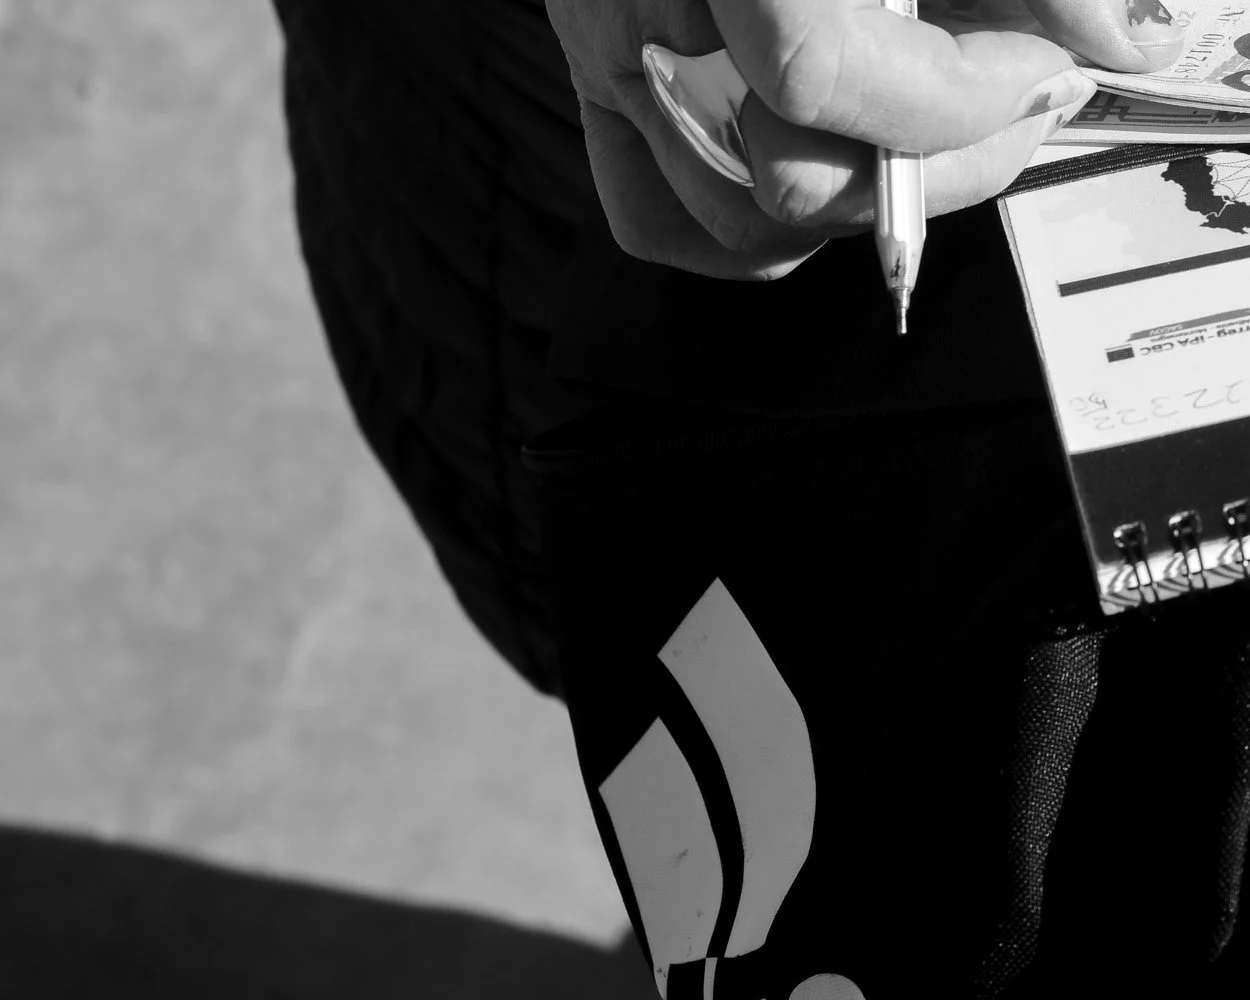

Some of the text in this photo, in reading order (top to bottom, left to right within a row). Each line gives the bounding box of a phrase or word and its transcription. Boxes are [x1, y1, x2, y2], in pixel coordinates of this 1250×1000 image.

[1174, 32, 1225, 75] 001748
[1149, 328, 1208, 343] Montenegro
[1140, 341, 1175, 357] CBC
